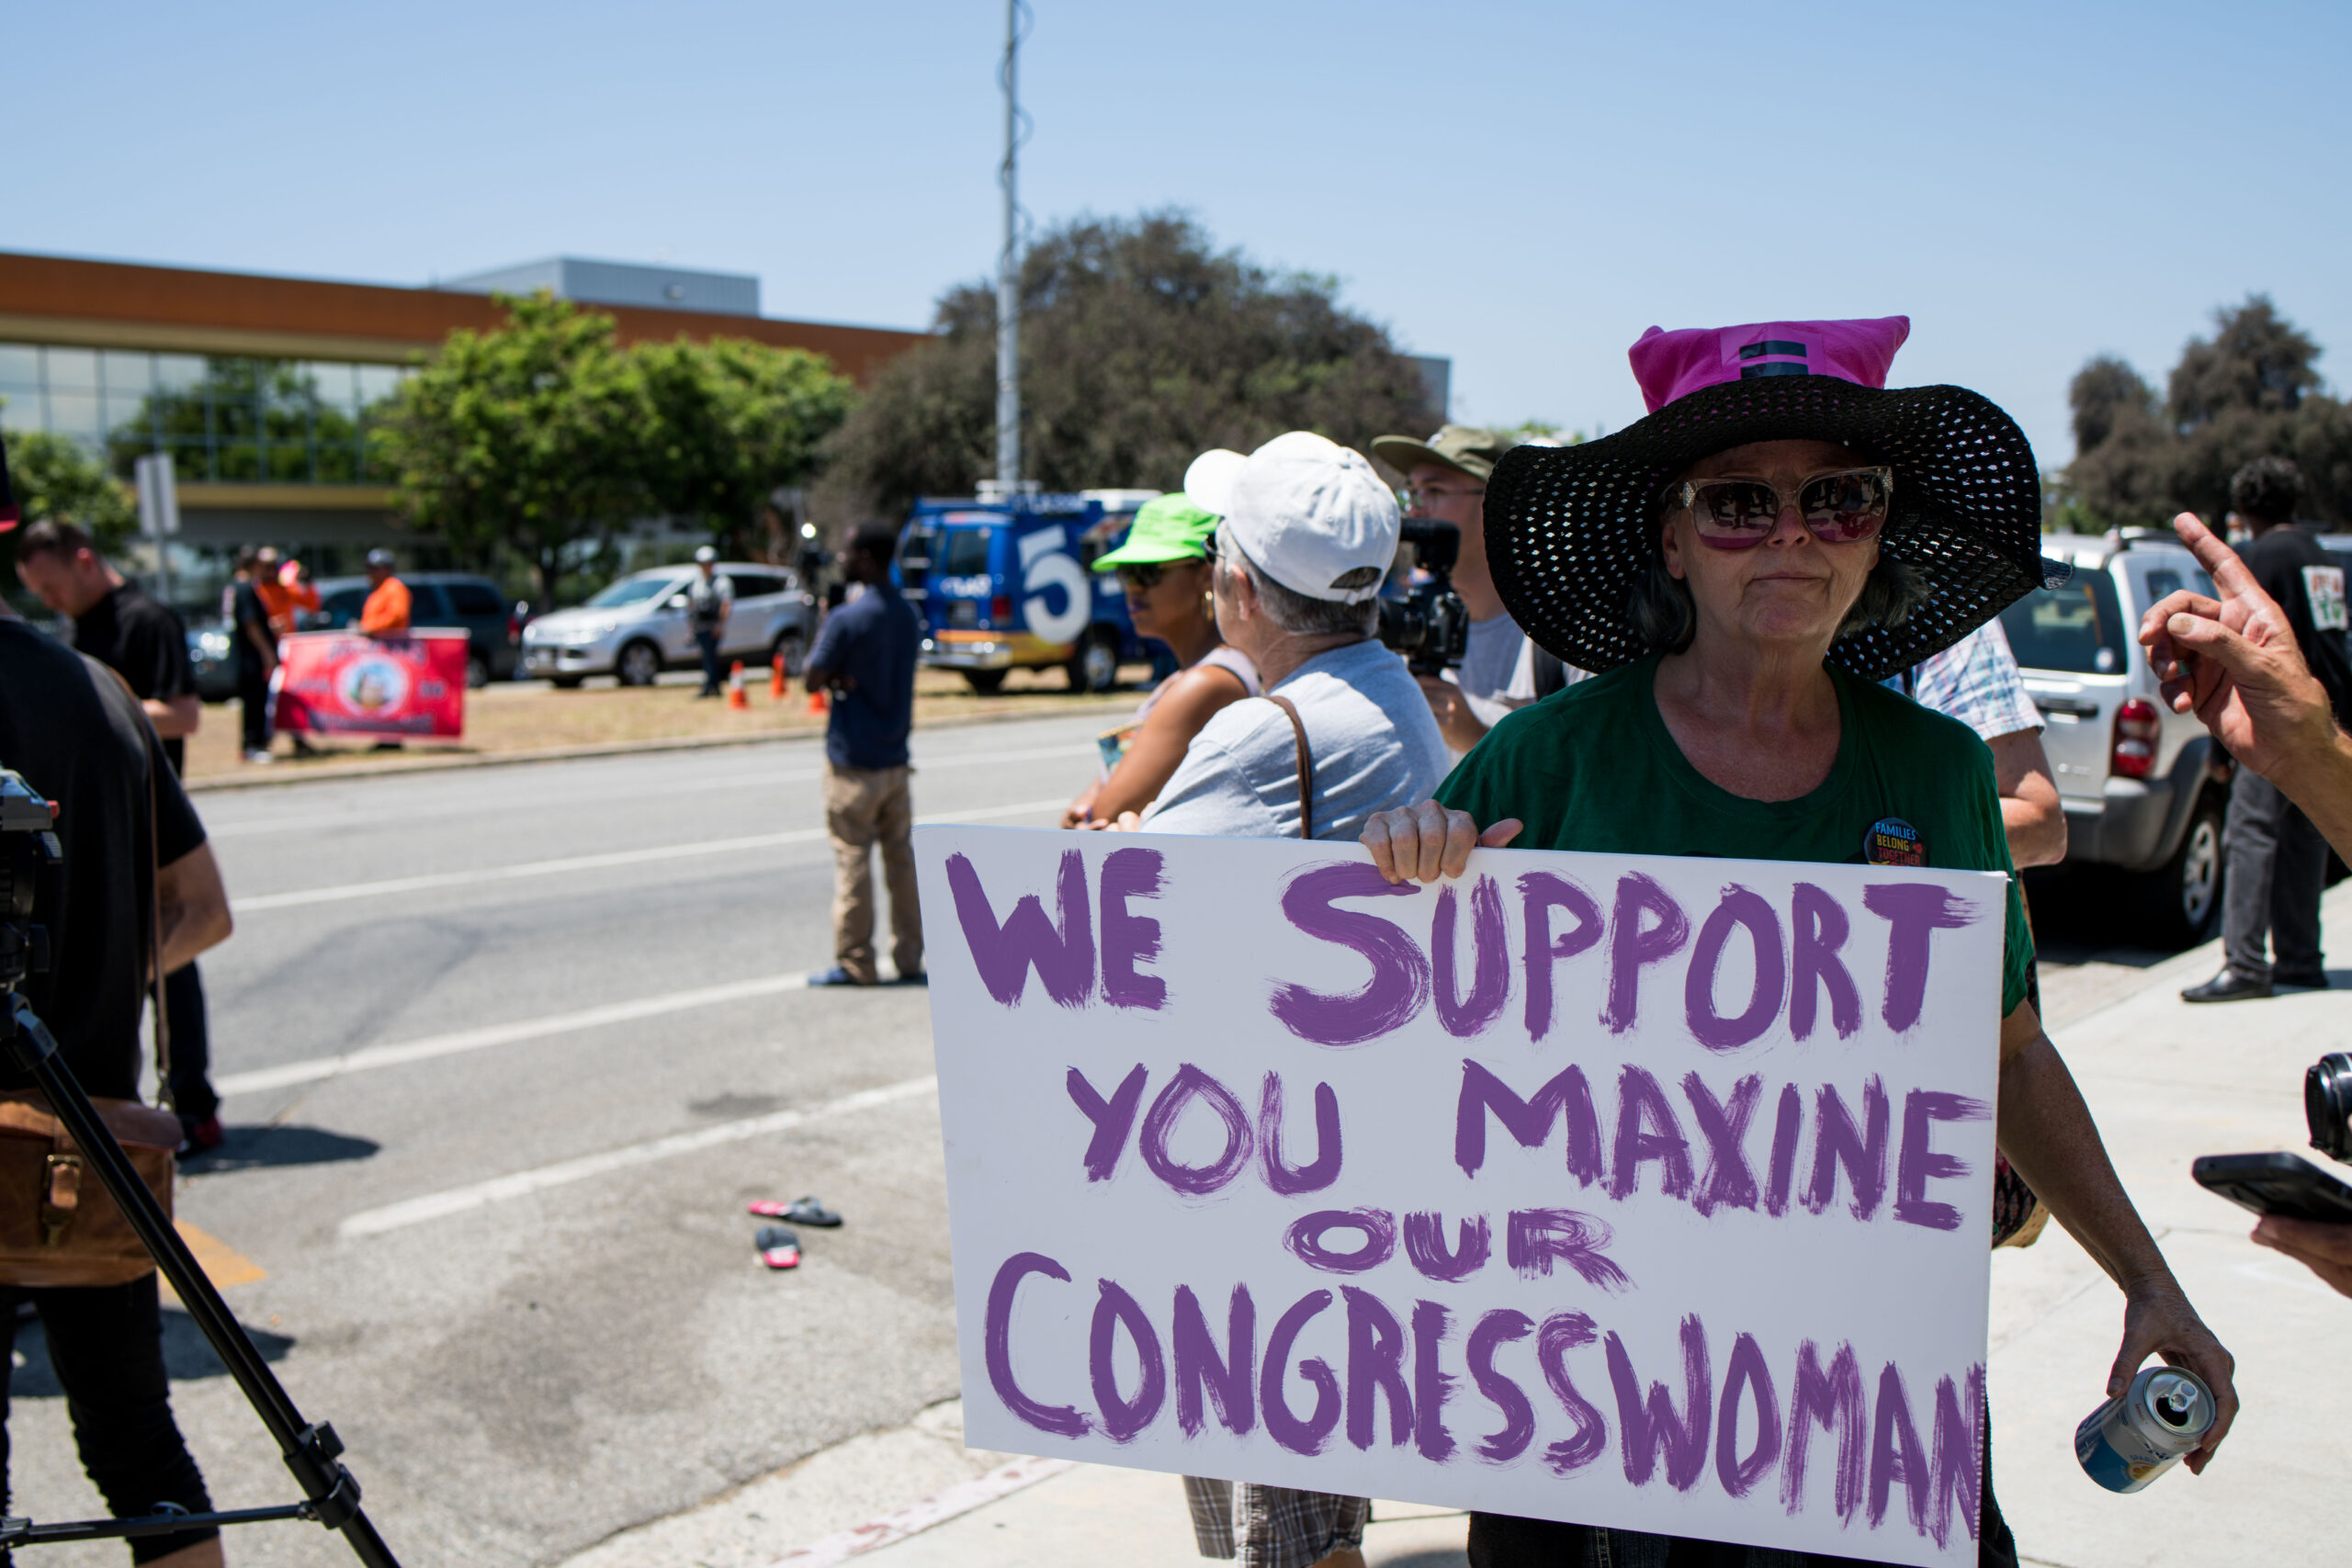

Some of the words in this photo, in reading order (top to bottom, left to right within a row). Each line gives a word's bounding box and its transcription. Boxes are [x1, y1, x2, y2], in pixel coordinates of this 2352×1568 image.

[1018, 525, 1091, 645] 5
[1875, 822, 1917, 840] FAMILIES
[1877, 834, 1909, 852] BELONG
[1878, 846, 1921, 866] TOGETHER
[945, 849, 1170, 1010] WE
[1270, 861, 1979, 1051] SUPPORT
[1067, 1062, 1342, 1197] YOU
[1454, 1058, 1992, 1231] MAXINE
[1283, 1206, 1635, 1291] OUR
[985, 1251, 1985, 1549] CONGRESSWOMAN
